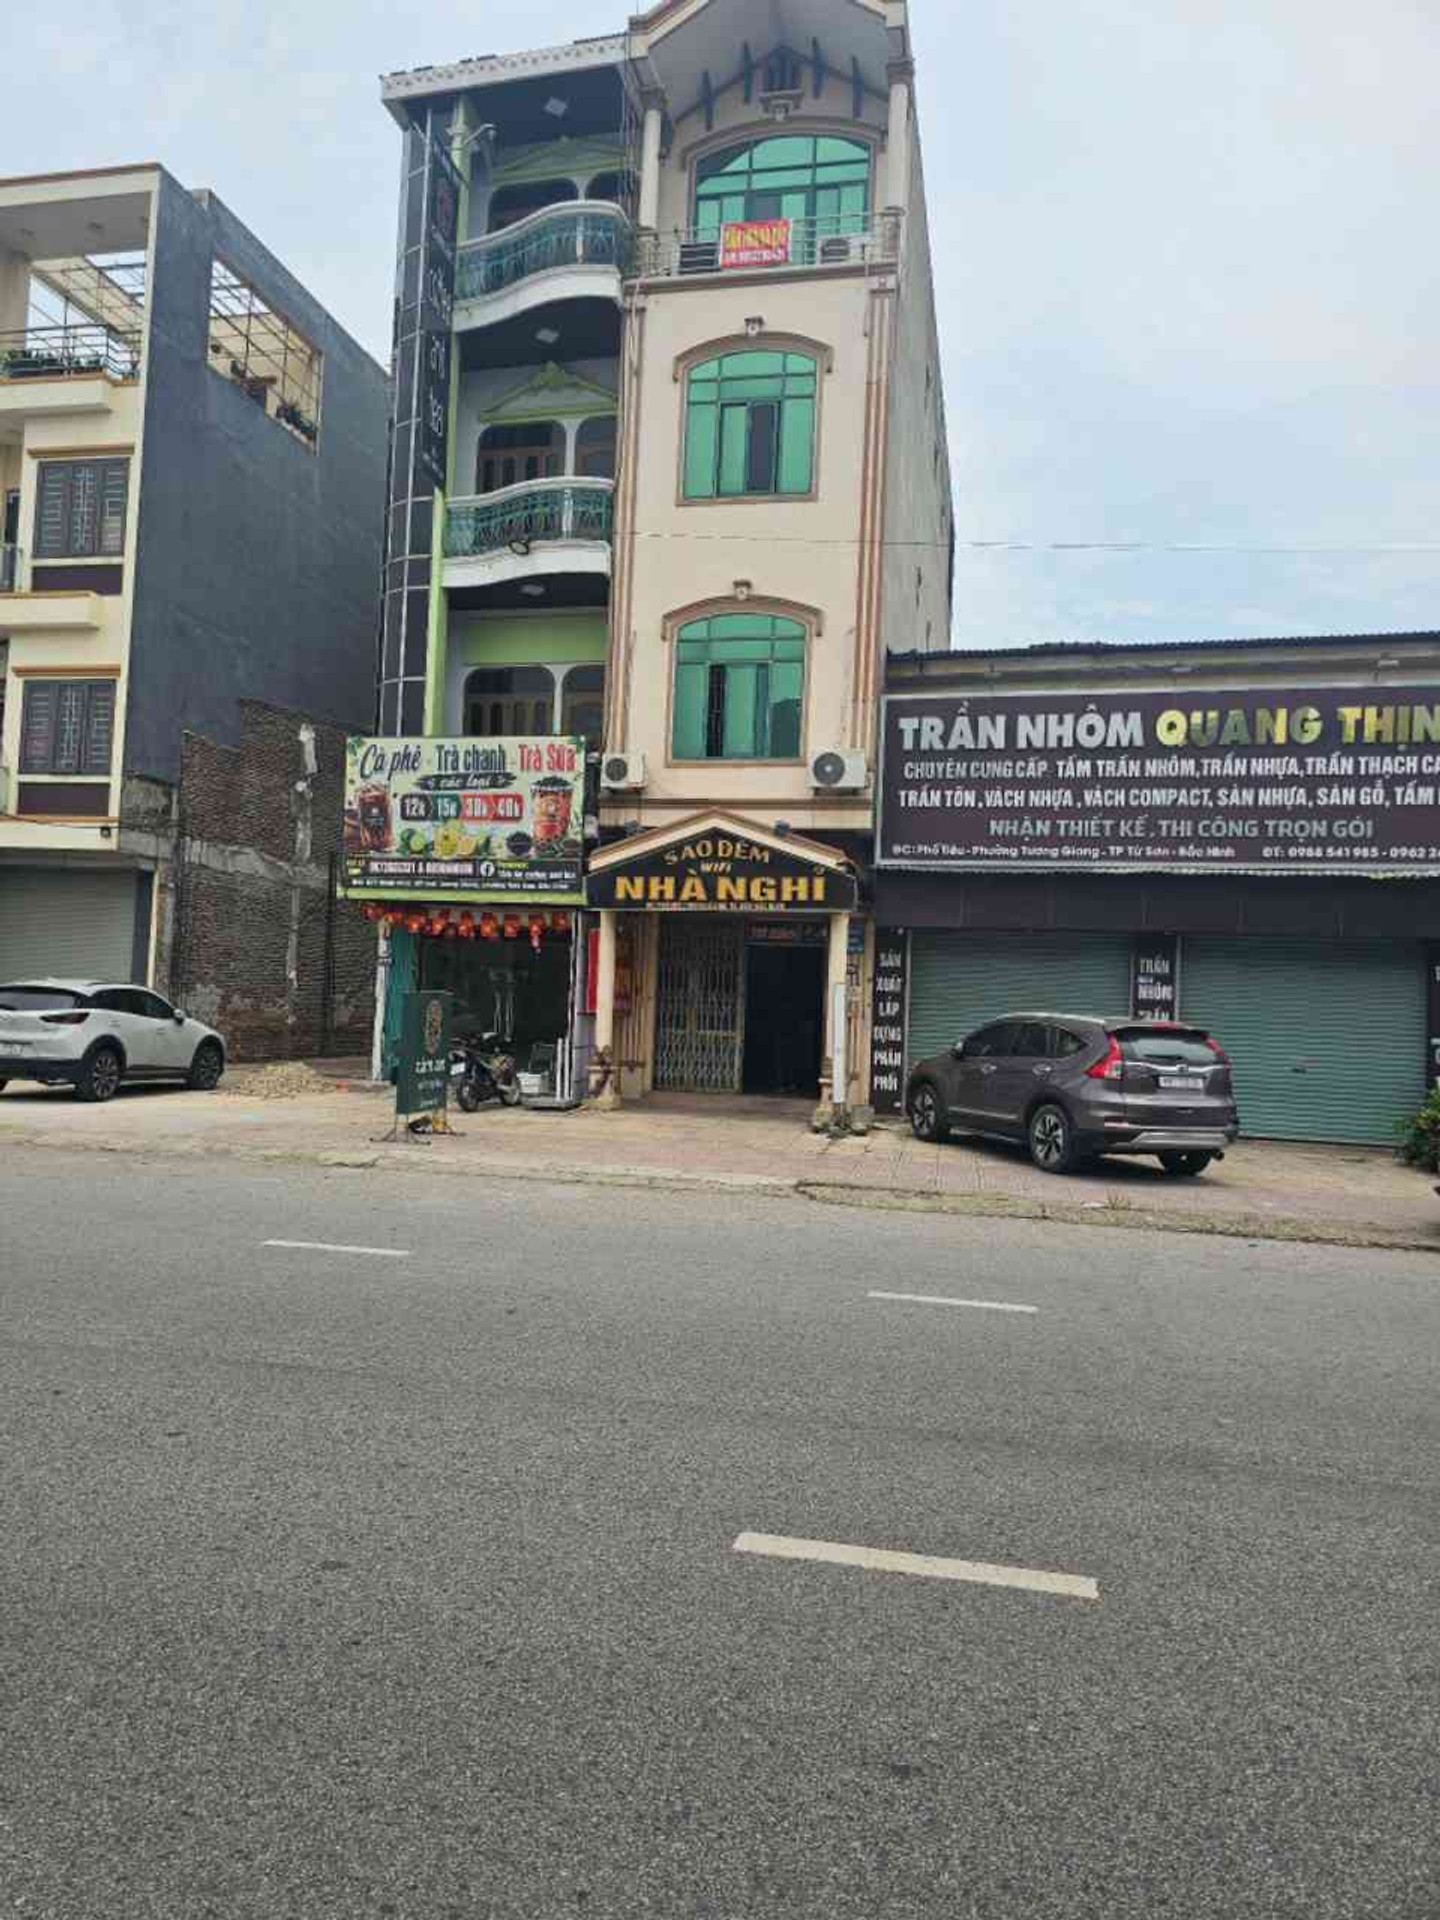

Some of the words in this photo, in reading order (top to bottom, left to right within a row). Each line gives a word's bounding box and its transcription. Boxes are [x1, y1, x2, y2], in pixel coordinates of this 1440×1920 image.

[1017, 703, 1144, 749] NHÔM
[1156, 706, 1323, 747] QUANG
[434, 744, 459, 772] Trà
[463, 744, 506, 772] chanh
[518, 744, 542, 772] Trà
[970, 760, 1013, 779] CUNG
[990, 815, 1051, 842] NHẬN
[1157, 818, 1193, 838] THI
[1198, 815, 1259, 838] CÔNG
[1264, 818, 1328, 843] TRỌN
[663, 840, 714, 865] SAO
[615, 868, 708, 901] NHÀ
[716, 866, 826, 902] NGHỈ
